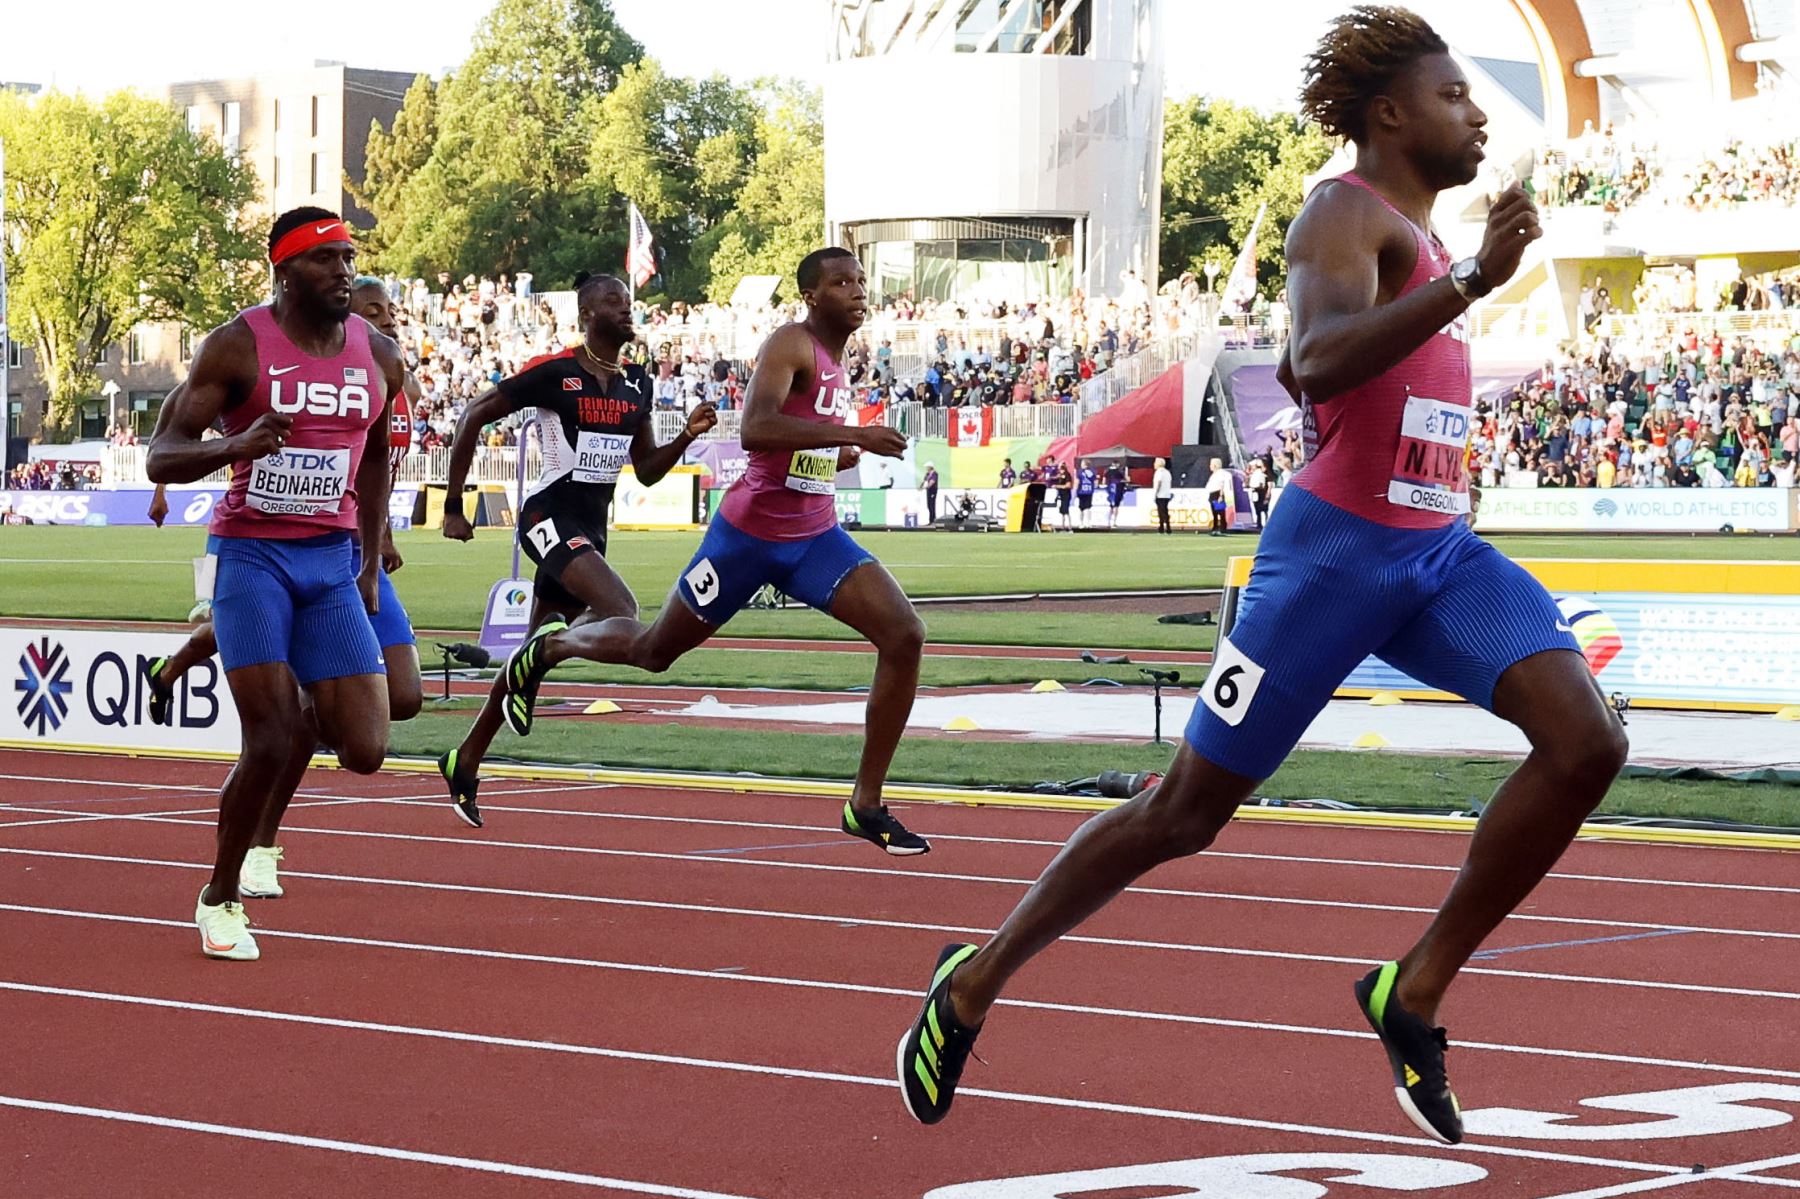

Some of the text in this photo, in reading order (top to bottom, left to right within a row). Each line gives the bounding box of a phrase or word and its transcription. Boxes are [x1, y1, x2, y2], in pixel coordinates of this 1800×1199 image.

[271, 380, 370, 419] USA
[578, 411, 620, 425] TOBAGO
[601, 437, 629, 450] TDK
[285, 453, 337, 471] TDK
[255, 469, 343, 496] BEDNAREK
[1494, 501, 1578, 516] ATHLETICS
[1625, 501, 1778, 517] WORLD ATHLETICS
[536, 527, 553, 549] 2
[694, 572, 714, 595] 3
[1214, 664, 1246, 709] 6
